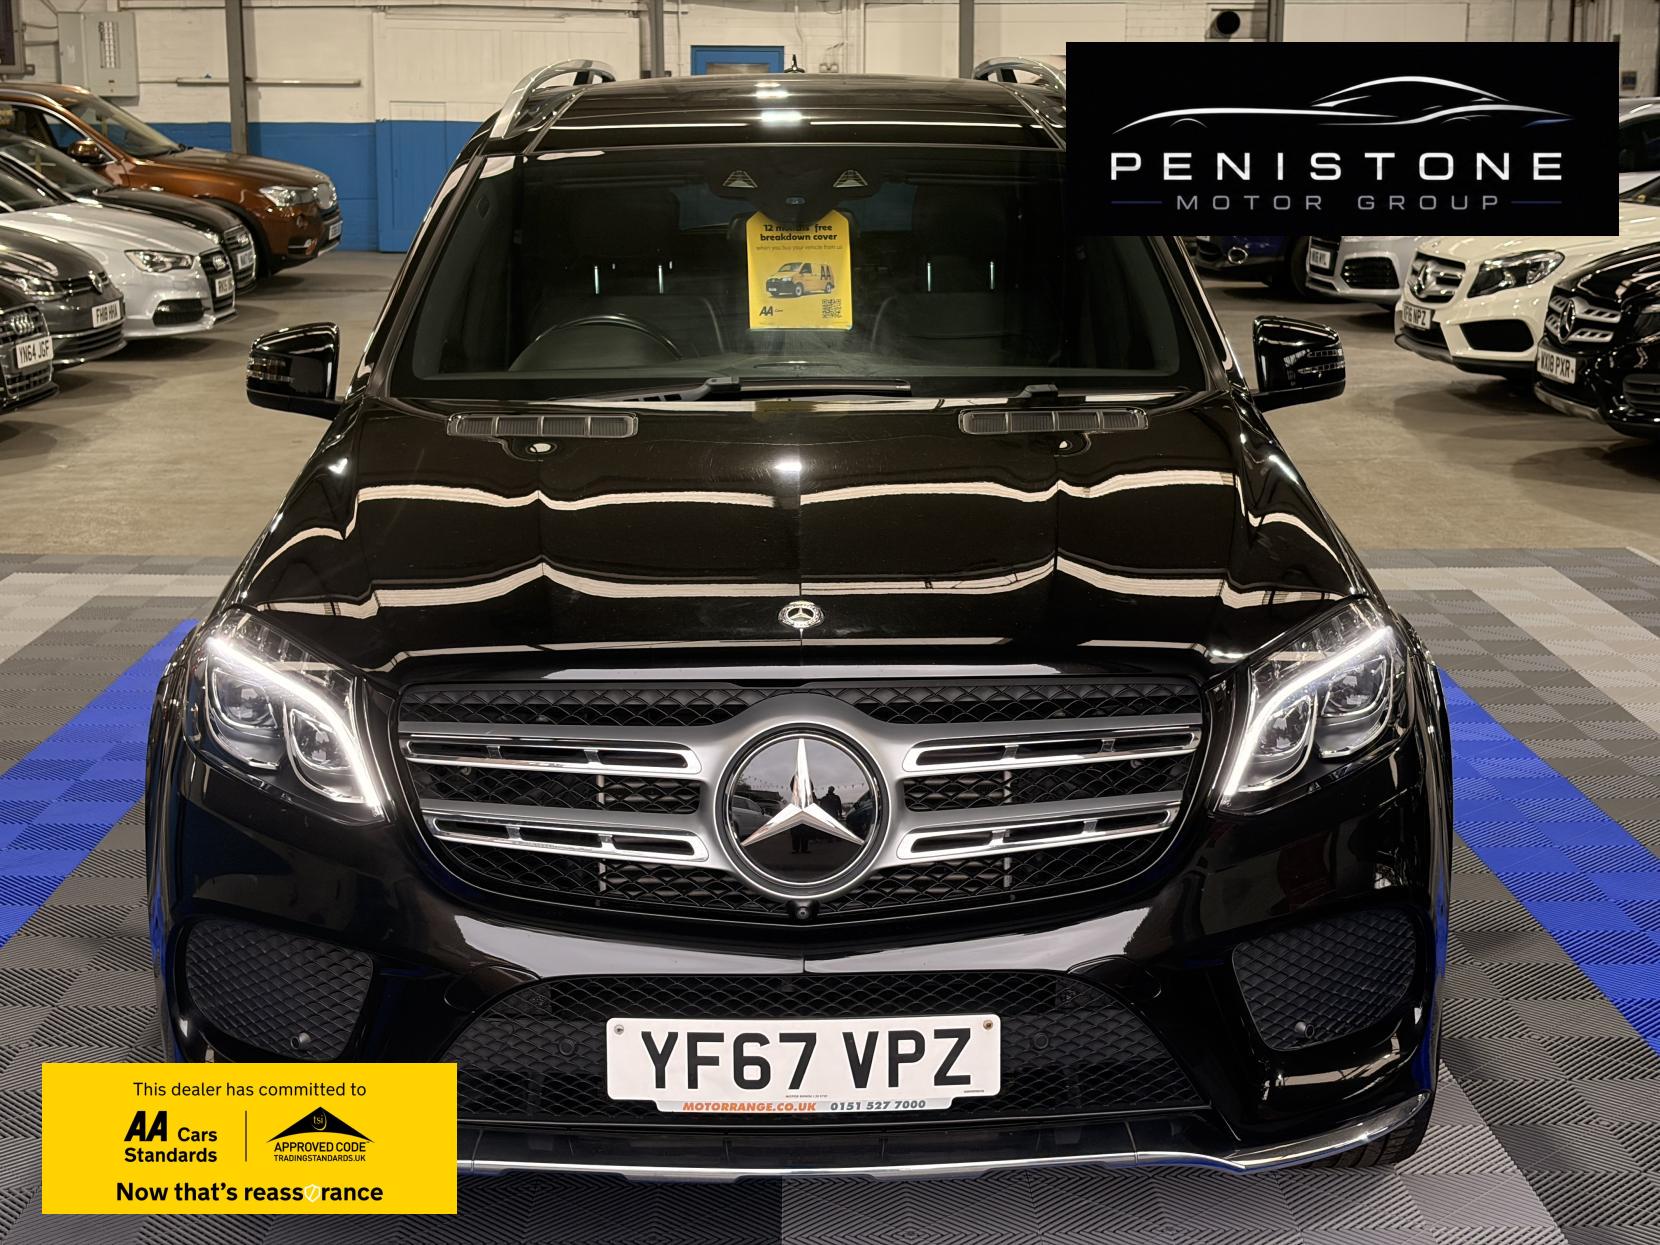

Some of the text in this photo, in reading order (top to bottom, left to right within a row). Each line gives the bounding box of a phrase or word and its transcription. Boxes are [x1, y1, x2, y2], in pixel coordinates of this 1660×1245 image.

[815, 223, 832, 233] free
[760, 233, 837, 241] breakdown cover
[760, 306, 774, 316] AA
[1413, 308, 1426, 326] NPZ
[18, 340, 50, 364] YN64 JGF
[1555, 356, 1571, 378] PXR
[640, 1027, 971, 1090] YF67 VPZ
[682, 1100, 926, 1112] MOTORRANGE.CO.UK 0151 527 7000
